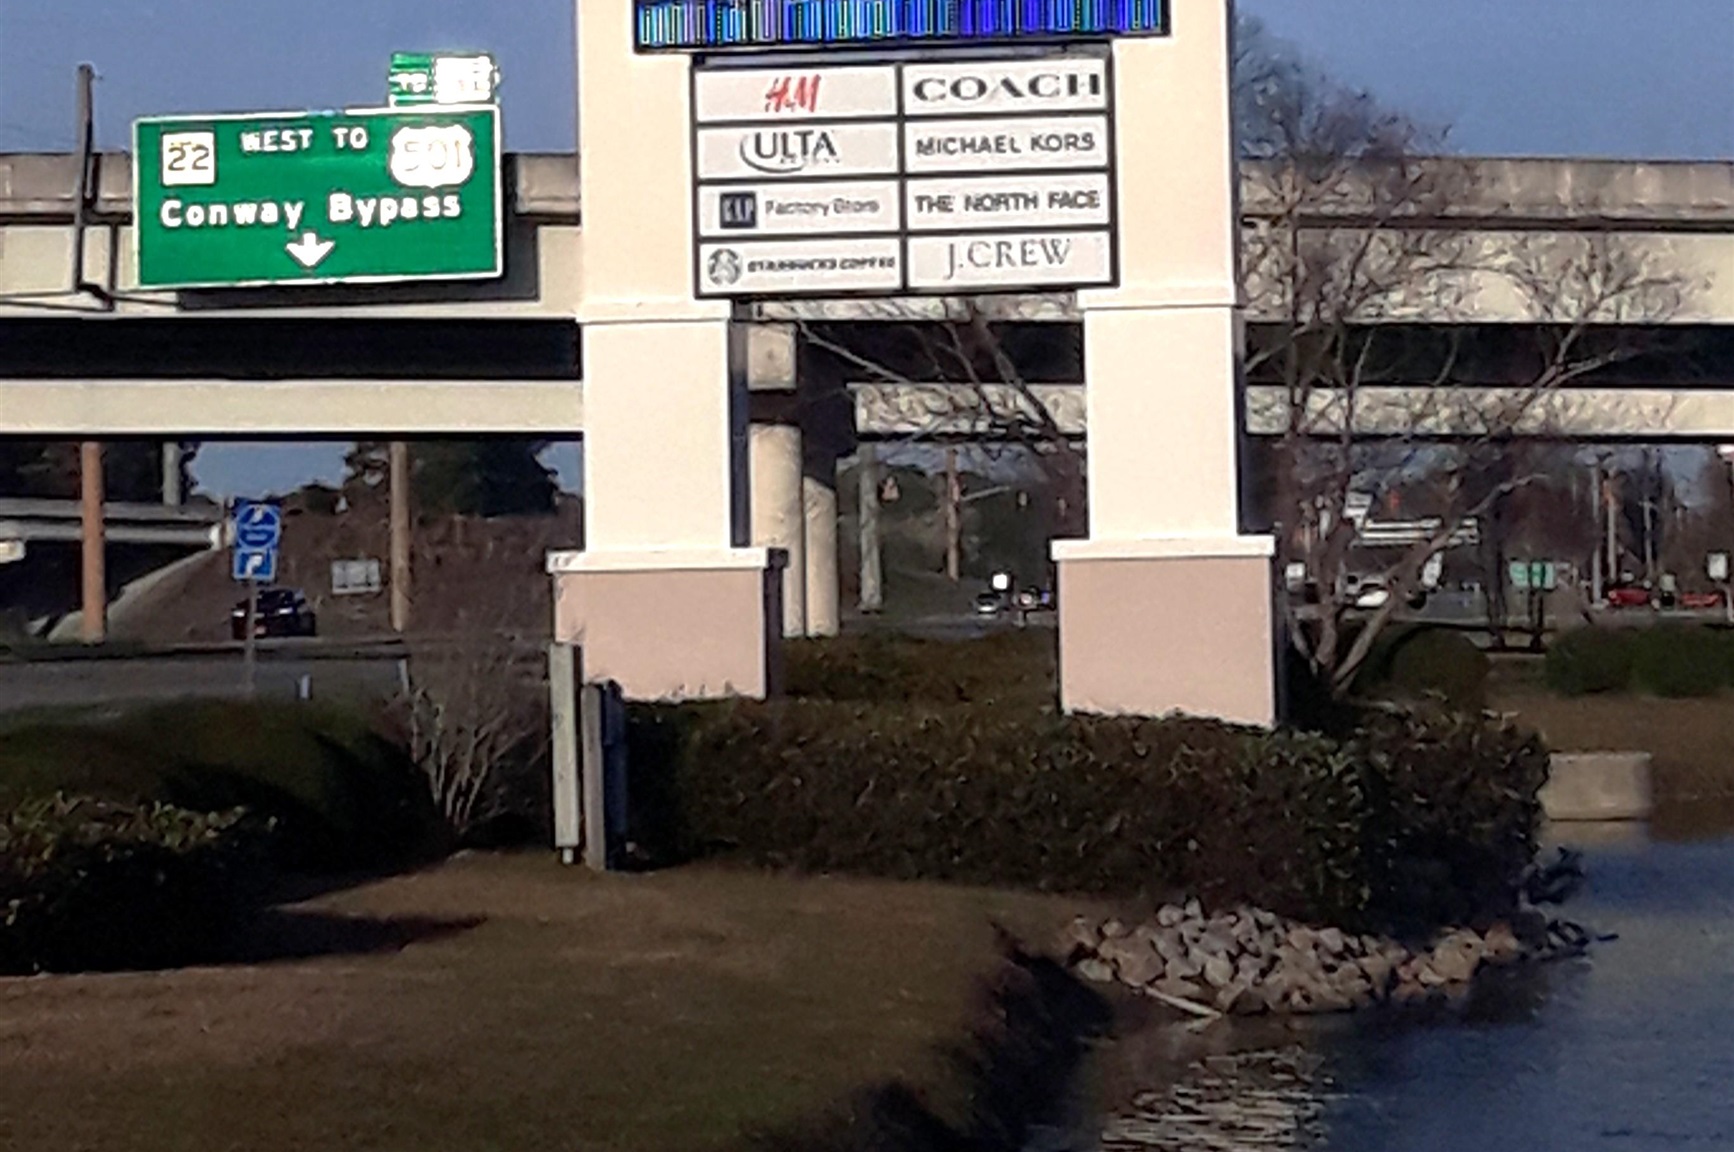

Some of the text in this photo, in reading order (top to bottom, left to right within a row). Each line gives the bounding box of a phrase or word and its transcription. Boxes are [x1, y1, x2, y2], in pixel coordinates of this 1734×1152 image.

[913, 73, 1100, 101] COACH
[167, 127, 463, 172] 22 WEST TO 501
[754, 129, 838, 160] ULTA
[915, 132, 1096, 156] MICHAEL KORS
[160, 191, 462, 230] Conway Bypass
[915, 189, 1101, 213] THE NORTH FACE
[943, 238, 1071, 280] J.CREW
